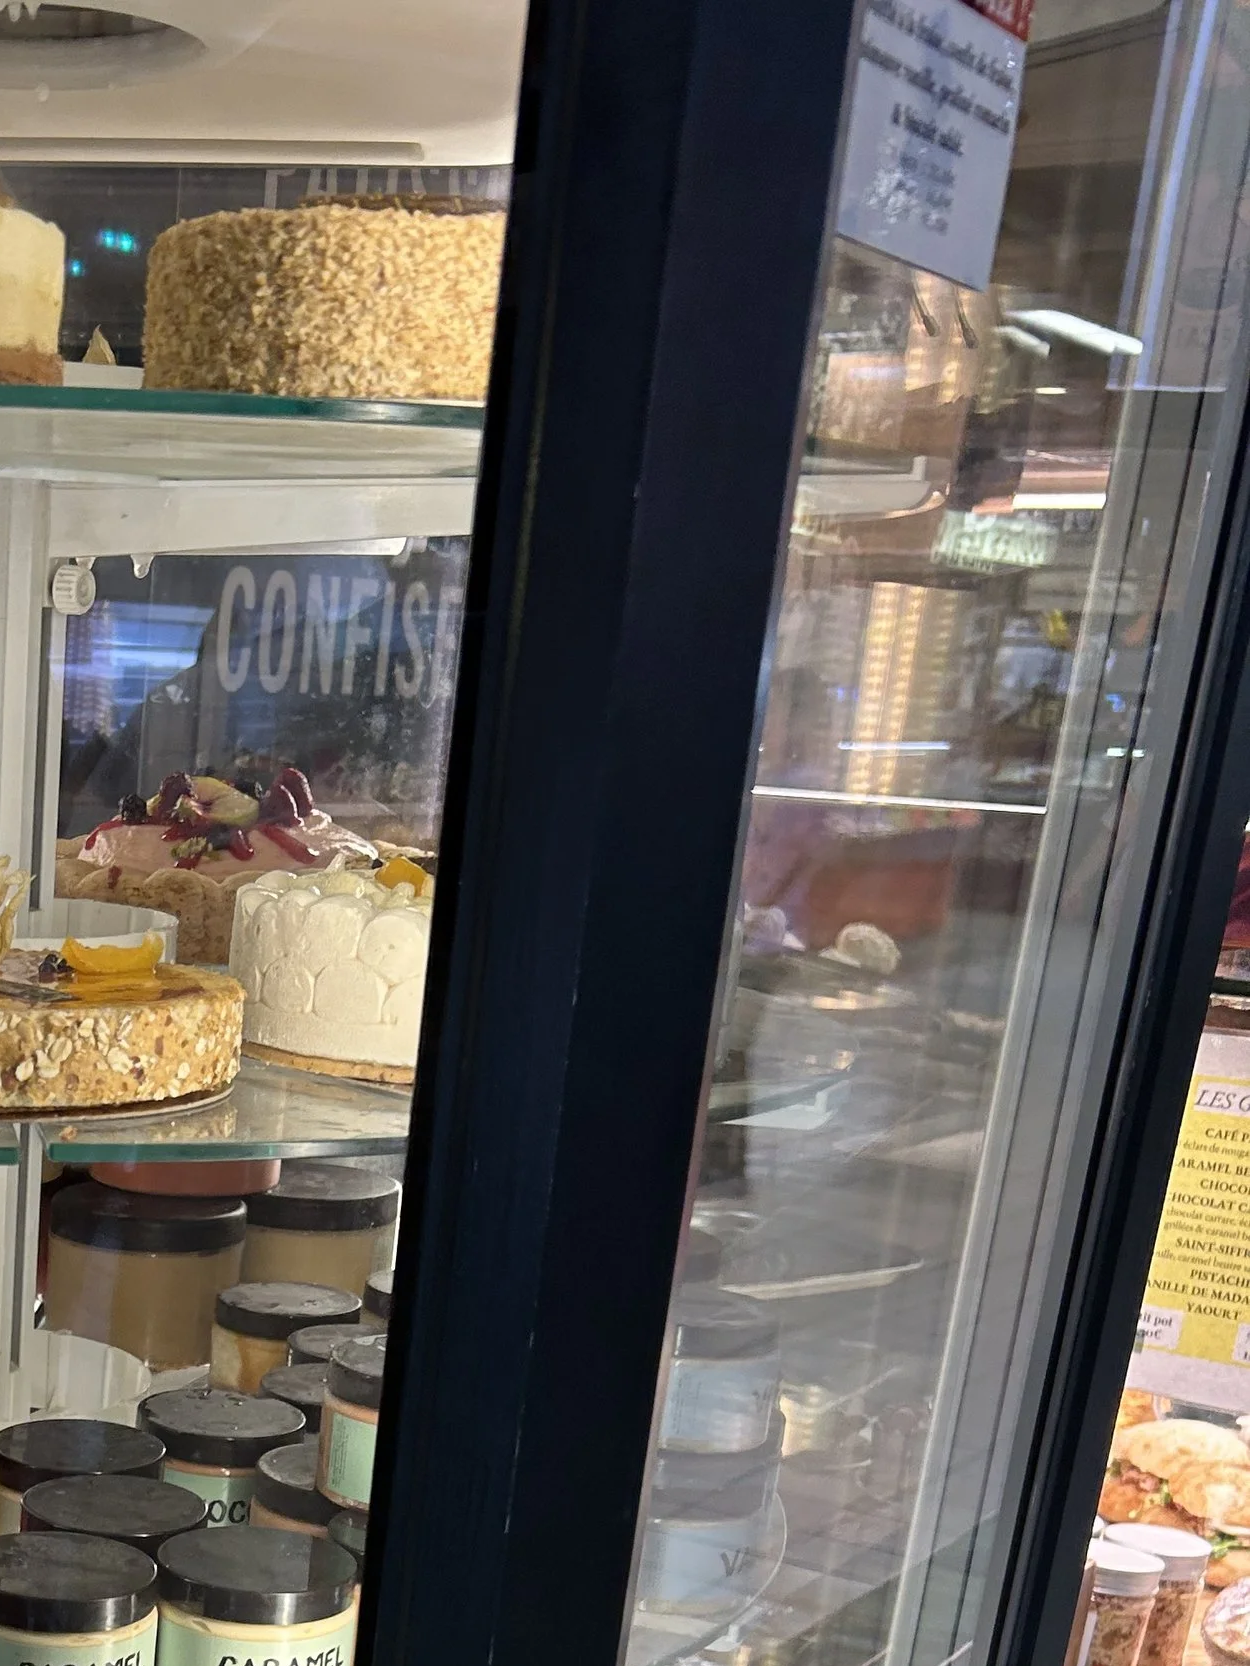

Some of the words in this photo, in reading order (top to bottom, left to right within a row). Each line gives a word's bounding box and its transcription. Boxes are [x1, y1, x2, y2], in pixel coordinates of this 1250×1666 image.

[1194, 1089, 1237, 1110] LES
[1205, 1127, 1239, 1142] CAFÉ
[1169, 1191, 1237, 1212] HOCOLAT
[1191, 1285, 1209, 1298] DE
[1187, 1302, 1242, 1321] YAOURT
